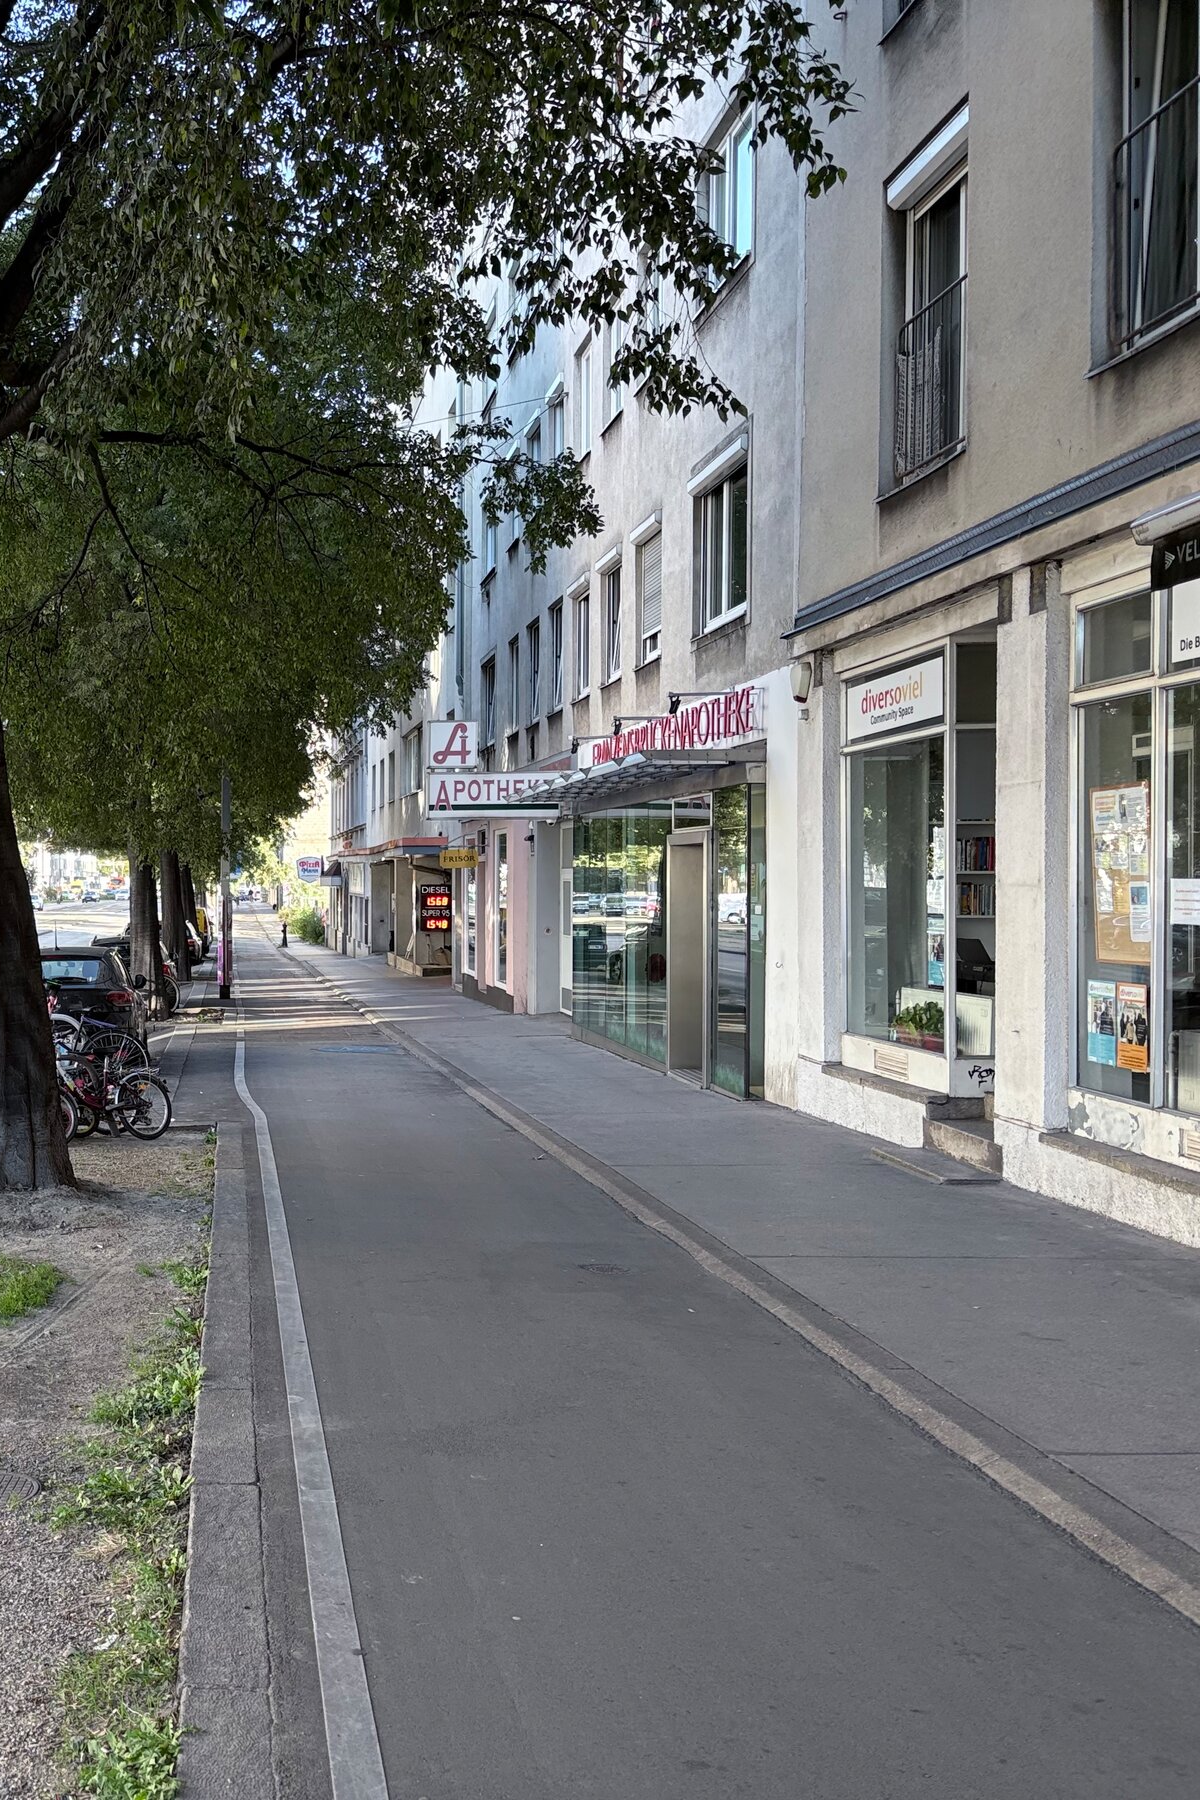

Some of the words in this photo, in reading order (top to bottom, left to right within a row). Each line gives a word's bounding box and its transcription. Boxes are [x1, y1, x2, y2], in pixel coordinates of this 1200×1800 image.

[1180, 637, 1193, 651] Die
[861, 671, 923, 715] diversoviel
[870, 709, 898, 725] Community
[898, 705, 914, 719] Space
[434, 779, 550, 811] APOTHE
[443, 854, 476, 863] FRISÖR
[421, 909, 440, 917] SUPER
[441, 909, 450, 917] 95
